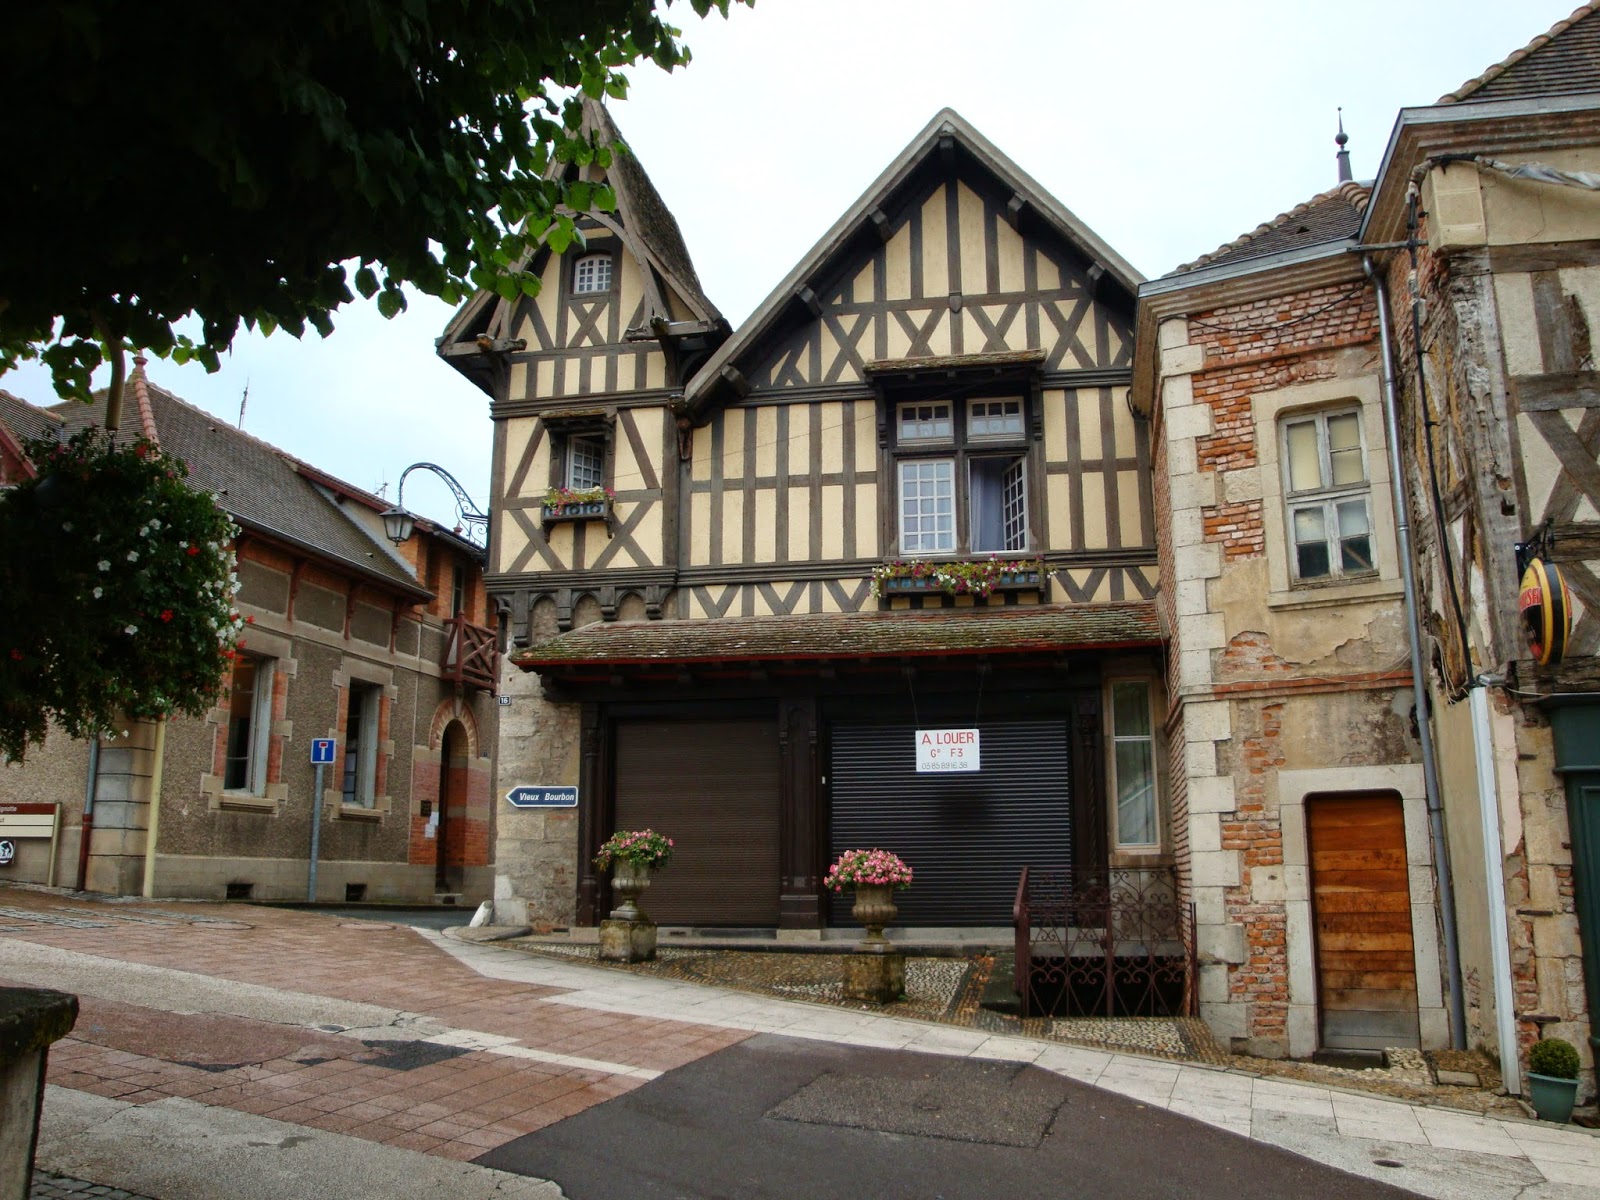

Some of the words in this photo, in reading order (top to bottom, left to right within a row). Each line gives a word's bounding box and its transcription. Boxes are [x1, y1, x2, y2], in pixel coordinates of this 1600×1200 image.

[922, 733, 932, 745] A
[936, 732, 975, 744] LOUER
[519, 793, 540, 801] Vieux
[544, 793, 575, 801] Bourbon
